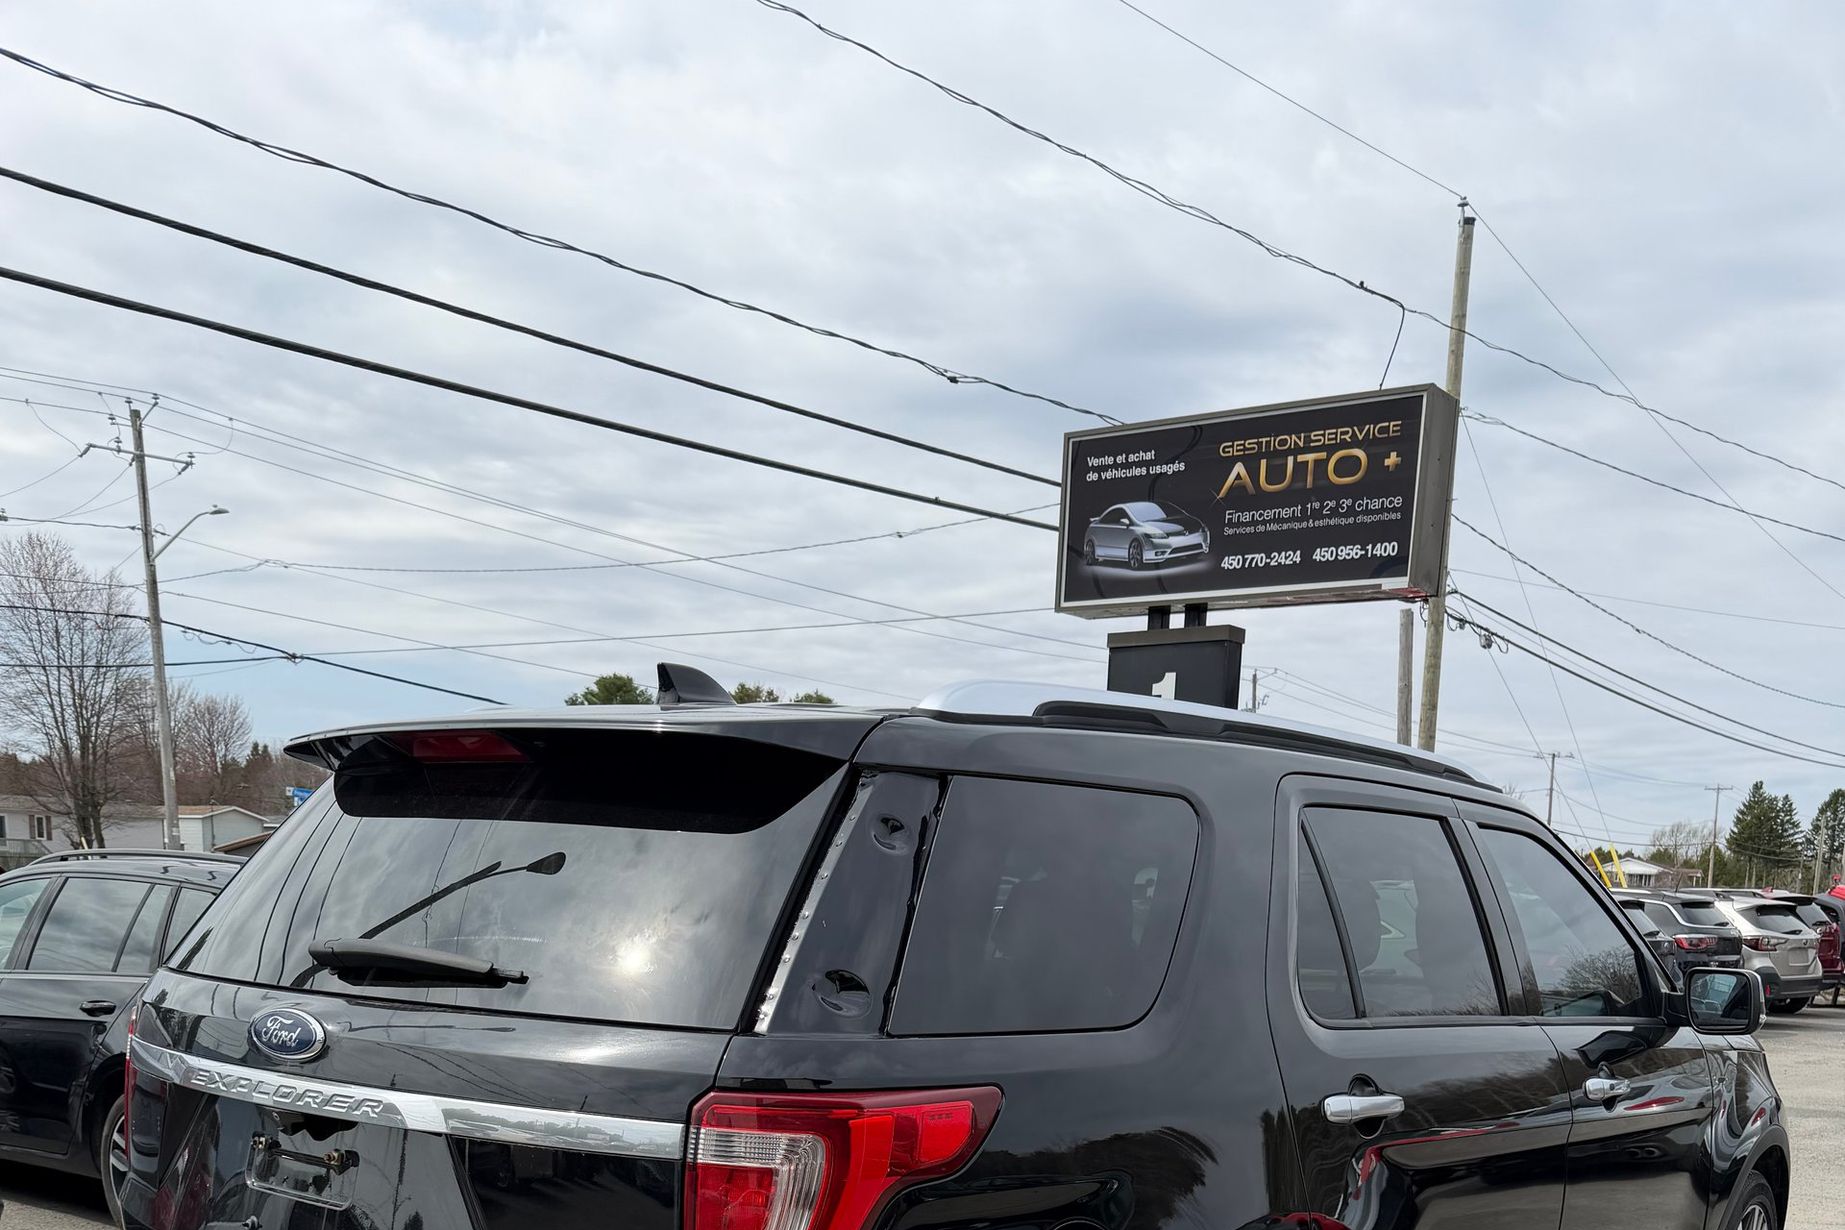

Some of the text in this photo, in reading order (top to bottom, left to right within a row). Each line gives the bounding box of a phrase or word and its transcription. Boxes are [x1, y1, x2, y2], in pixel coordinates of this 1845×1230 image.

[1219, 421, 1402, 457] GESTION SERVICE
[1086, 460, 1185, 481] de véhicules usagés
[1087, 449, 1155, 467] Vente et achat
[1217, 448, 1368, 499] AUTO
[1225, 504, 1301, 524] Financement
[1355, 496, 1403, 511] chance
[1223, 511, 1401, 536] Services de Mécanique & esthétique disponibles
[1220, 550, 1301, 570] 450 770-2424
[1312, 541, 1399, 562] 450 956-1400
[261, 1015, 302, 1048] Ford
[190, 1069, 385, 1118] EXPLORER
